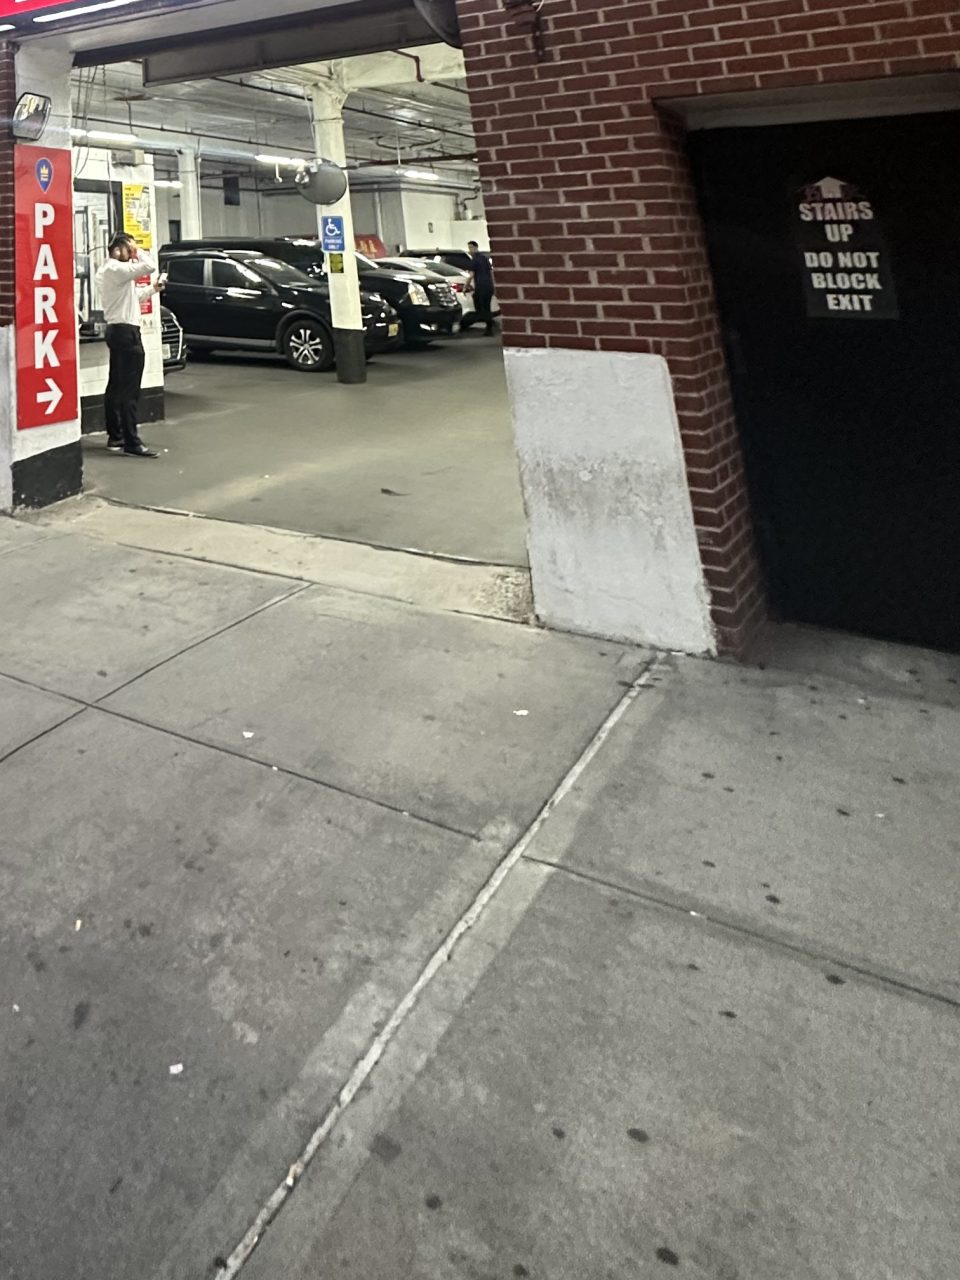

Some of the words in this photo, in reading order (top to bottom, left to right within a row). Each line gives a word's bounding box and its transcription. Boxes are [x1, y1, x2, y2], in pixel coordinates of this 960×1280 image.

[798, 201, 874, 221] STAIRS
[824, 223, 854, 242] UP
[803, 251, 833, 268] DO
[837, 251, 880, 268] NOT
[32, 202, 61, 369] PARK
[811, 272, 883, 289] BLOCK
[826, 293, 874, 311] EXIT
